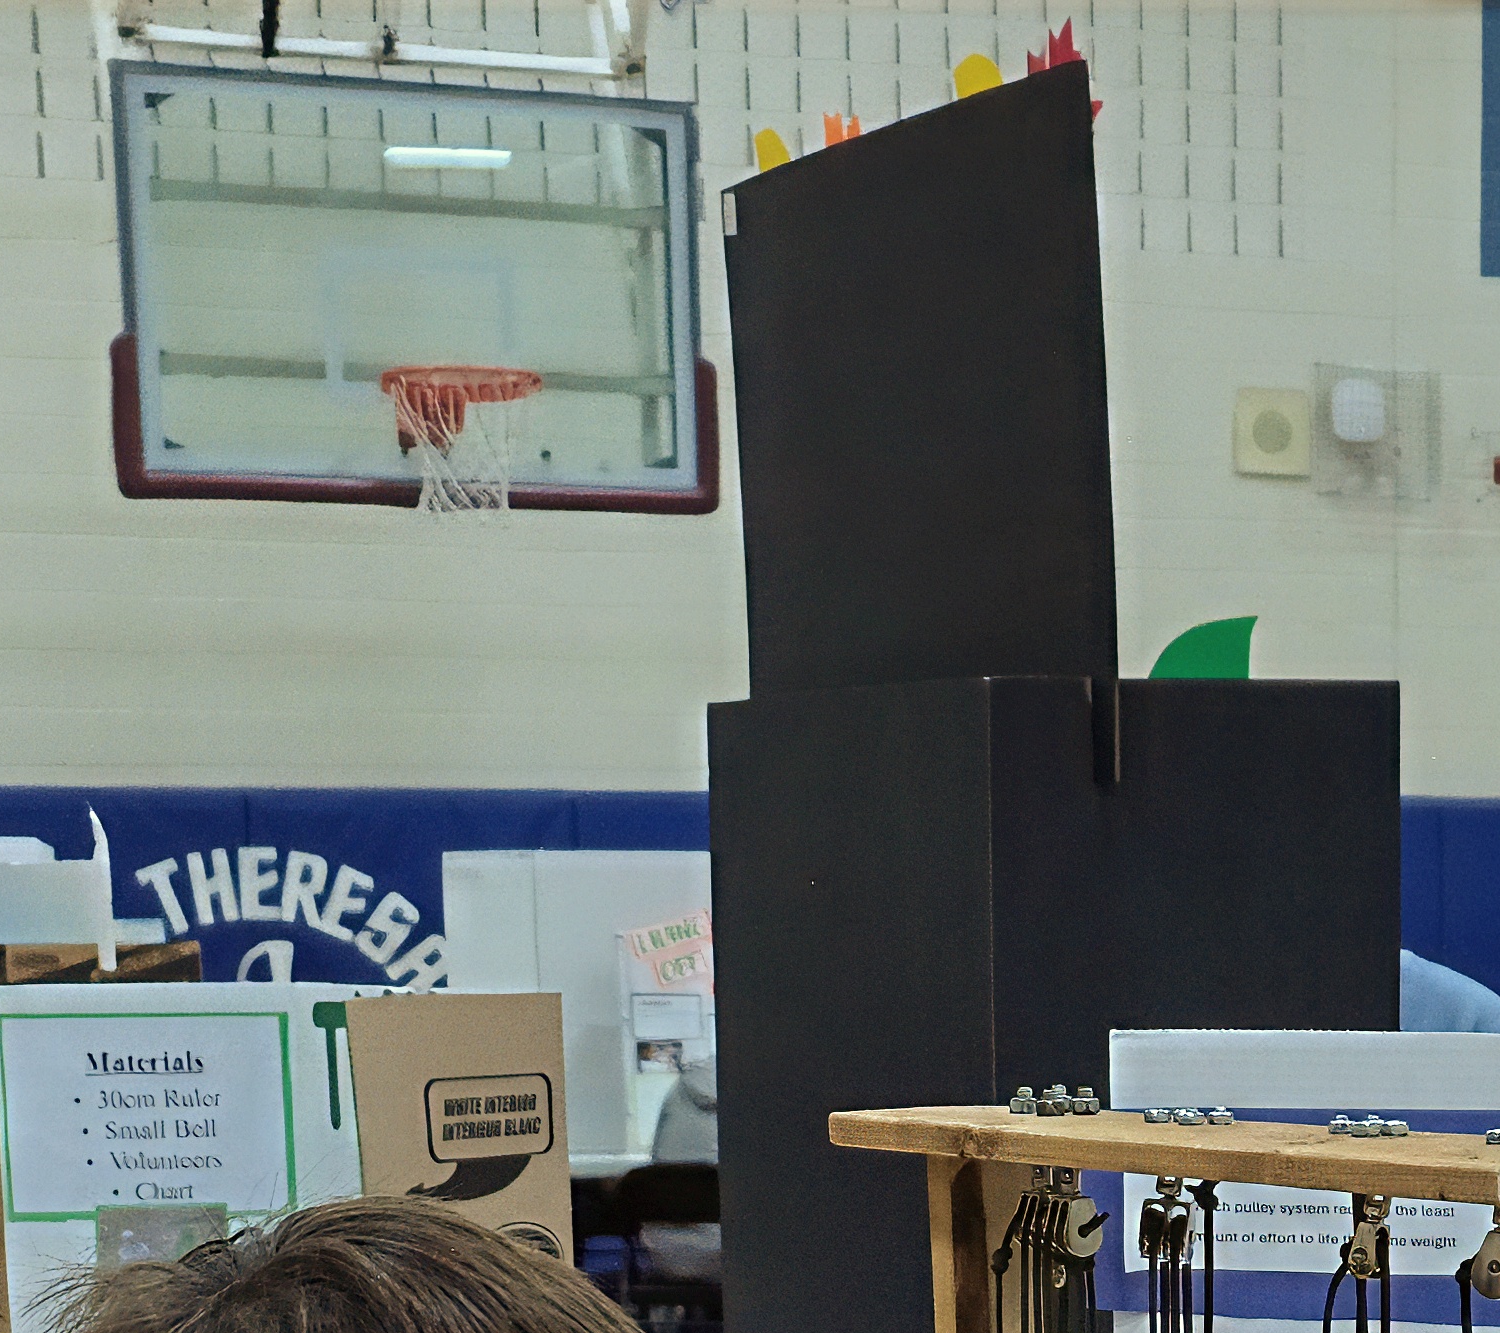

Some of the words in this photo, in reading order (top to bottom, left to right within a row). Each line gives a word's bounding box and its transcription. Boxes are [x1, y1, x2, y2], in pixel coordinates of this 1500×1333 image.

[136, 845, 450, 991] THERESA
[85, 1050, 204, 1072] Materials
[105, 1119, 166, 1140] Small
[174, 1118, 217, 1138] Bell
[109, 1151, 223, 1170] Volunteers
[135, 1182, 194, 1200] Chart
[1234, 1202, 1276, 1216] pulley
[1280, 1204, 1330, 1217] system
[1421, 1205, 1456, 1218] least
[1258, 1232, 1297, 1244] effort
[1300, 1233, 1314, 1244] to
[1410, 1236, 1457, 1250] weight
